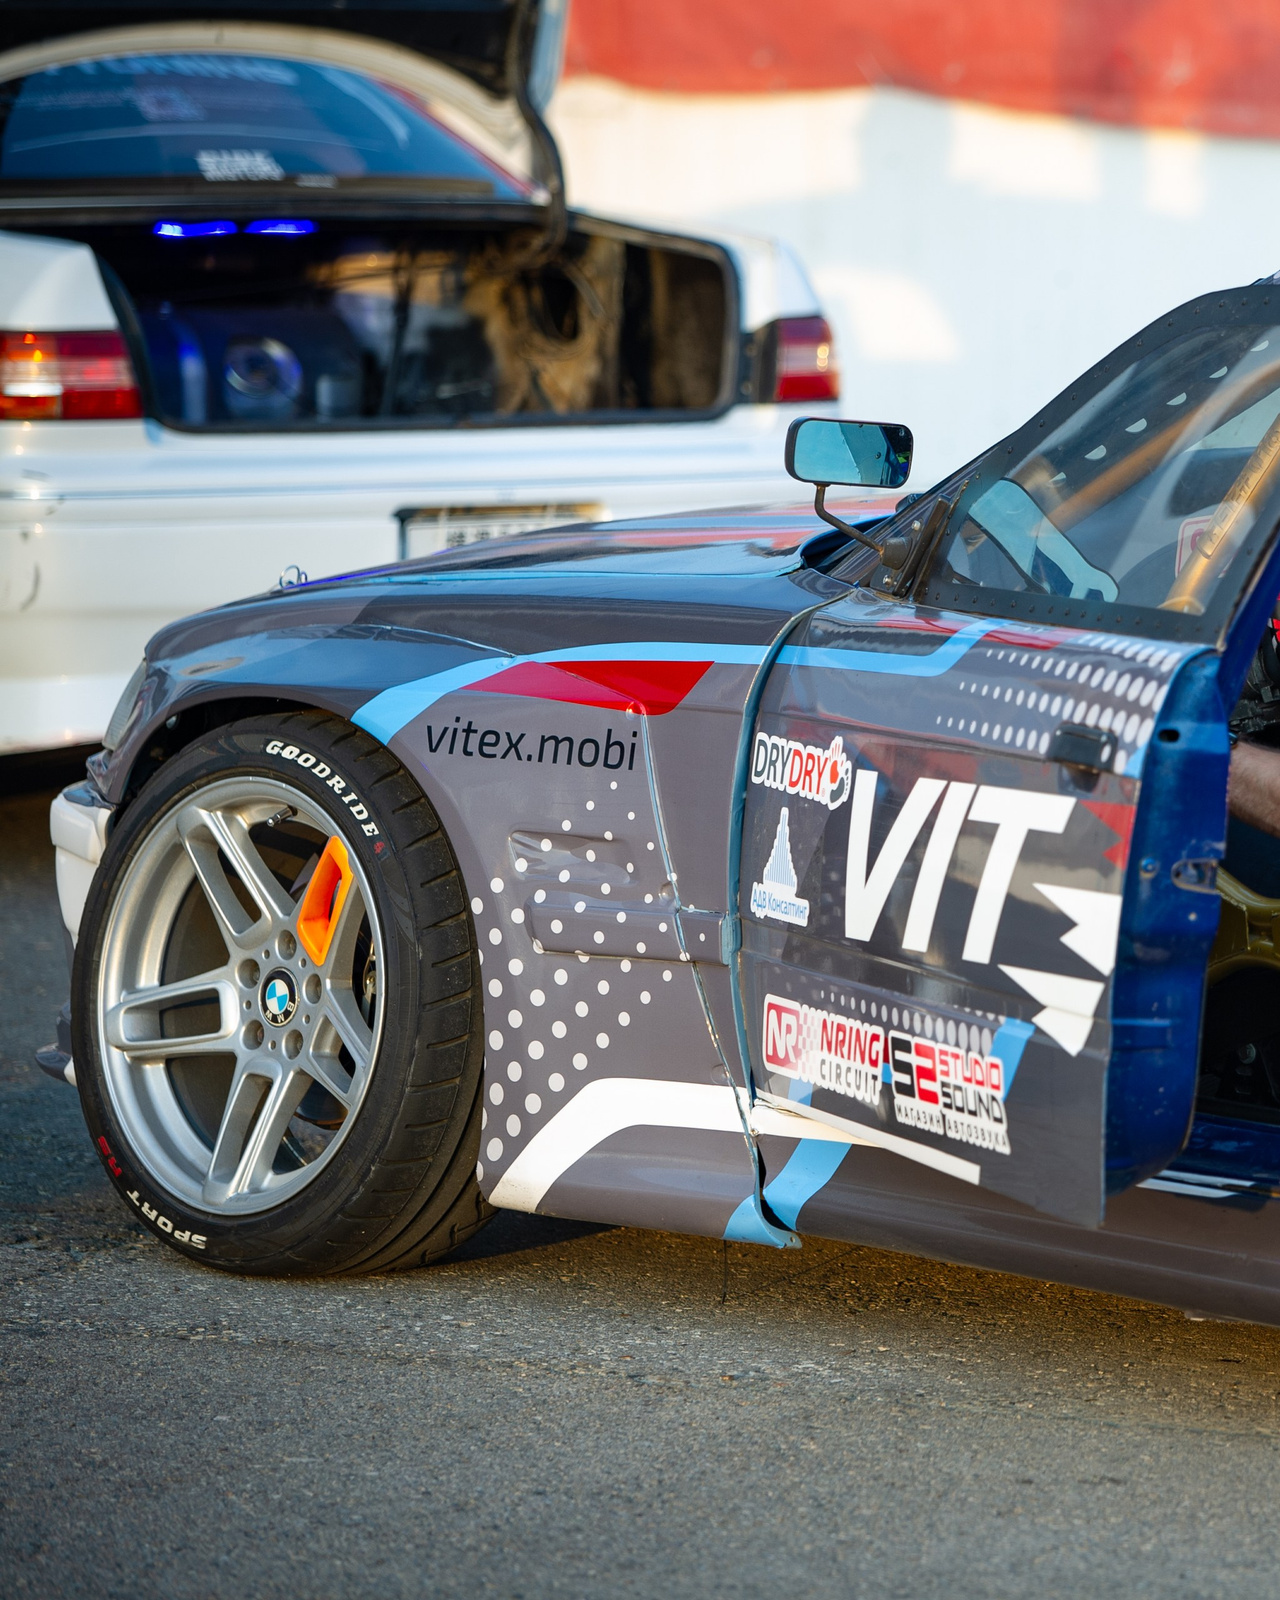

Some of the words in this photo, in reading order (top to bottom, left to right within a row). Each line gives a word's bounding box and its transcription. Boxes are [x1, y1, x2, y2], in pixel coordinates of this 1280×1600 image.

[426, 716, 638, 771] vitex.mobi
[753, 738, 829, 796] DRYDRY
[265, 740, 380, 837] GOODRIDE
[768, 891, 808, 920] Консалтинг
[265, 1001, 295, 1023] BMW
[767, 1008, 798, 1064] NR
[820, 1018, 881, 1069] NRING
[820, 1058, 879, 1097] CIRCUIT
[938, 1048, 1001, 1091] STUDIO
[896, 1103, 941, 1131] МАГАЗИН
[948, 1118, 1007, 1147] АВТОЗВУКА
[940, 1080, 1004, 1125] SOUND
[126, 1189, 208, 1250] SPORT
